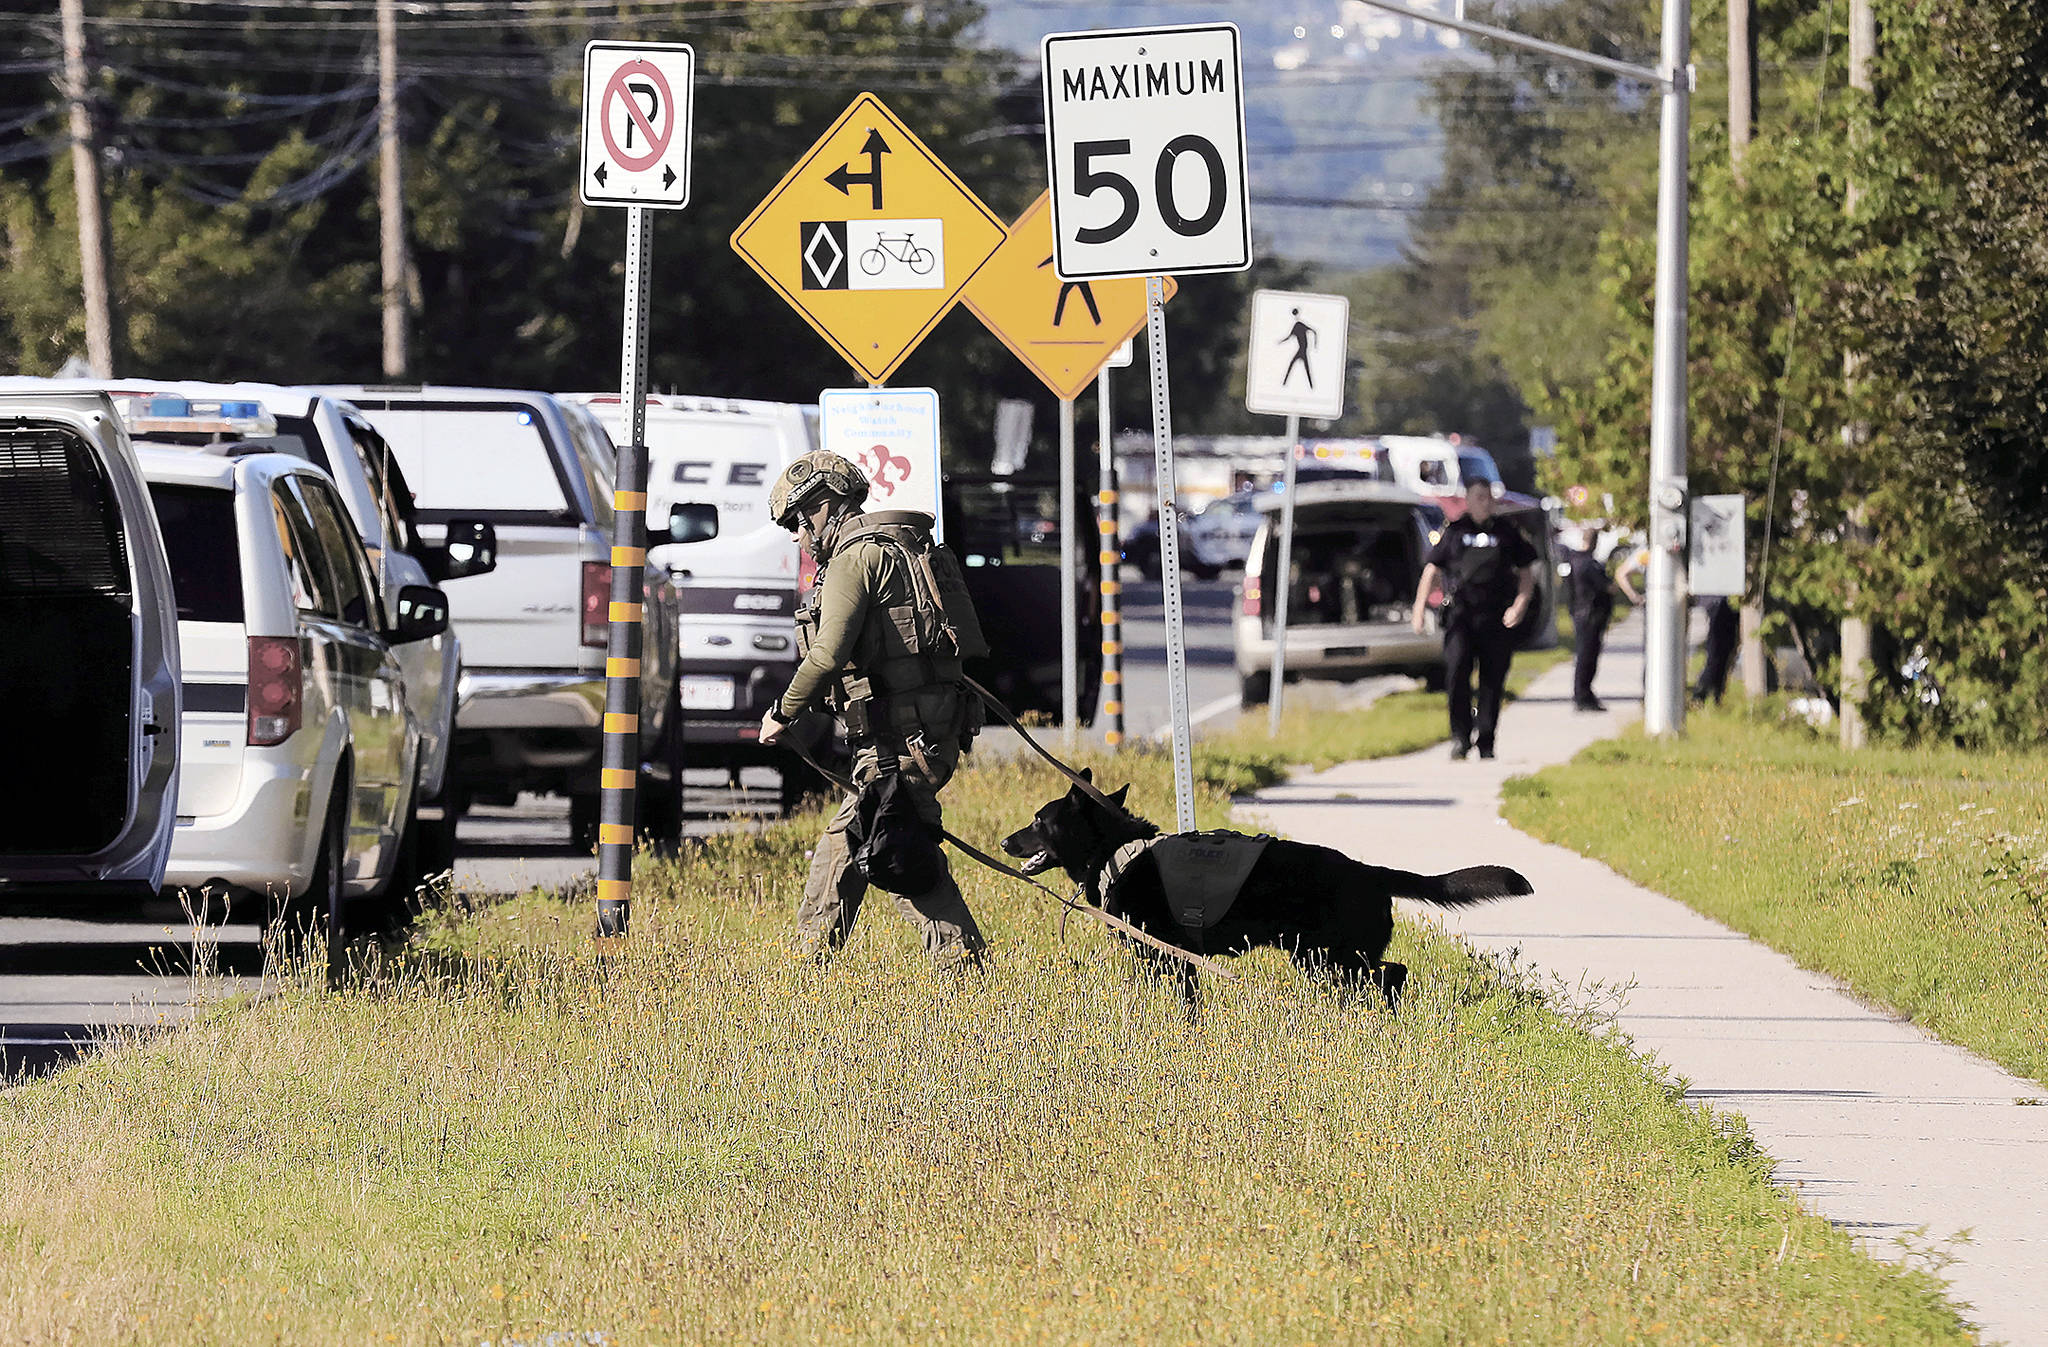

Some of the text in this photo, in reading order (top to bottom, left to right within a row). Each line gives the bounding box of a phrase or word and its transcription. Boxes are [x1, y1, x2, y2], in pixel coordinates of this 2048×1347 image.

[1063, 59, 1224, 102] MAXIMUM
[626, 83, 658, 149] P
[1073, 134, 1227, 245] 50
